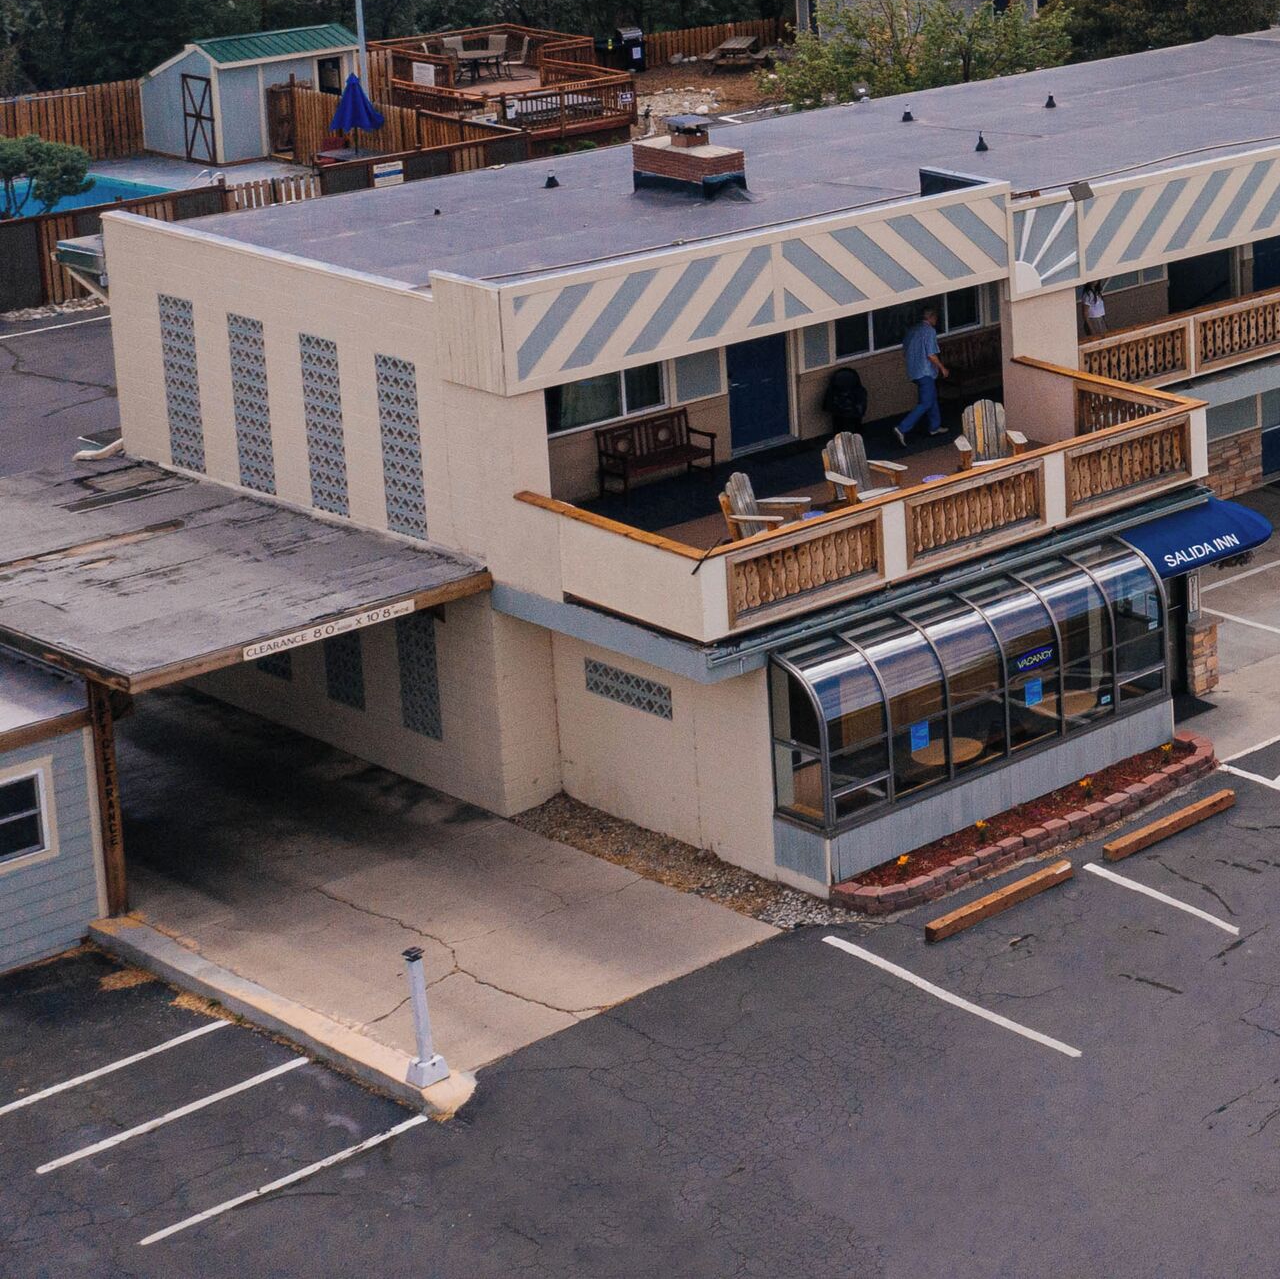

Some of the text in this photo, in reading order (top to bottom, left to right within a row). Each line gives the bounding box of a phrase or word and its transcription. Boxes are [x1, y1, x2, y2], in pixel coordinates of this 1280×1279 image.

[1164, 533, 1240, 567] SALIDA INN
[246, 634, 308, 658] CLEARANCE
[1017, 649, 1053, 669] VACANCY
